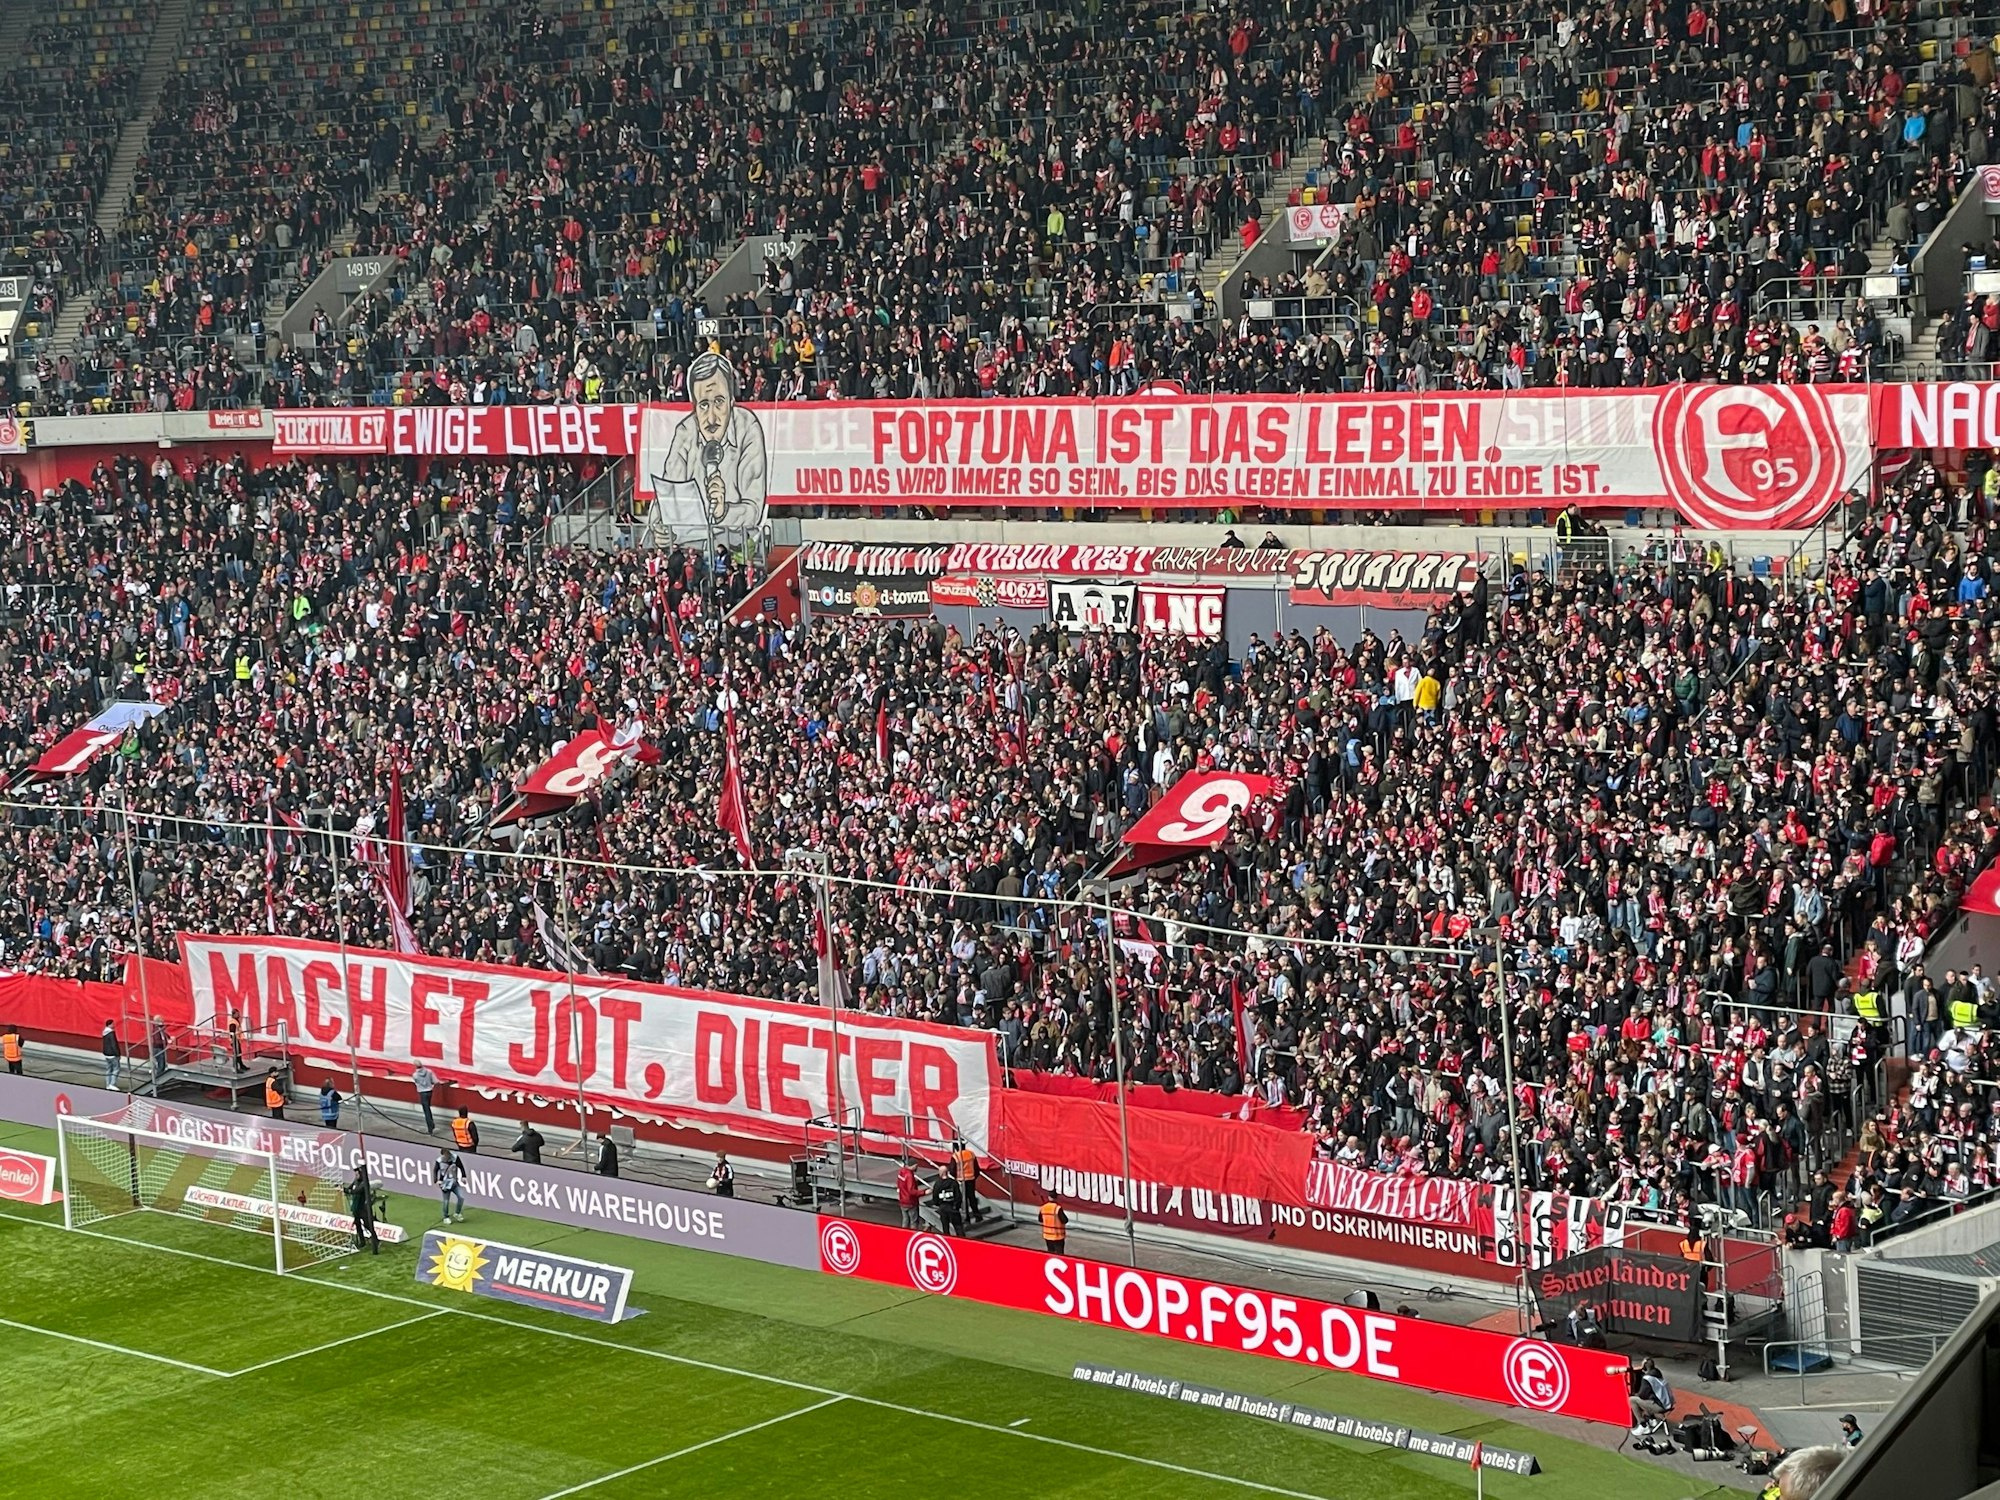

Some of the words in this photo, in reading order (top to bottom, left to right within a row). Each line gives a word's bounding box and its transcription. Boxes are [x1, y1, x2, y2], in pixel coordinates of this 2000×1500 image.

[347, 263, 363, 277] 149
[364, 262, 381, 276] 150
[0, 283, 15, 296] 48
[699, 321, 717, 335] 152
[273, 416, 353, 446] FORTUNA
[394, 408, 488, 454] EWIGE
[504, 406, 607, 456] LIEBE
[874, 408, 1079, 465] FORTUNA
[1097, 407, 1174, 464] IST
[1189, 405, 1291, 464] DAS
[1305, 402, 1502, 464] LEBEN.
[796, 468, 843, 494] UND
[850, 468, 890, 494] DAS
[897, 468, 947, 495] WIRD
[952, 468, 1021, 495] IMMER
[1029, 468, 1061, 494] SO
[1069, 467, 1128, 497] SEIN,
[1136, 468, 1177, 496] BIS
[1185, 468, 1229, 496] DAS
[1235, 468, 1311, 496] LEBEN
[1318, 466, 1420, 496] EINMAL
[1427, 466, 1457, 495] ZU
[1465, 464, 1543, 496] ENDE
[1553, 463, 1611, 495] IST.
[1752, 457, 1799, 491] 95
[854, 545, 914, 577] FIRE
[947, 543, 1070, 572] DIVISION
[1071, 545, 1155, 573] WEST
[1152, 546, 1217, 571] ANGRY
[1227, 548, 1293, 572] YOUTH
[997, 581, 1047, 600] 40625
[1294, 551, 1470, 600] SQUADRA
[1055, 592, 1078, 621] A
[1142, 593, 1223, 636] LNC
[1157, 778, 1251, 843] 9
[207, 951, 388, 1052] MACH
[411, 973, 491, 1066] ET
[508, 989, 667, 1099] JOT,
[694, 1010, 960, 1140] DIETER
[154, 1112, 274, 1154] LOGISTISCH
[279, 1135, 433, 1187] ERFOLGREICH
[459, 1166, 503, 1200] ANK
[510, 1176, 561, 1210] C&K
[565, 1185, 726, 1240] WAREHOUSE
[188, 1189, 220, 1205] KÜCHEN
[220, 1196, 252, 1211] AKTUELL
[1305, 1160, 1479, 1226] EINERZHAGEN
[256, 1202, 289, 1218] KÜCEN
[289, 1210, 323, 1225] AKTUELL
[1311, 1210, 1482, 1256] DISKRIMINIERUN
[840, 1252, 852, 1263] 95
[493, 1255, 612, 1304] MERKUR
[931, 1270, 945, 1283] 95
[1044, 1257, 1400, 1378] SHOP.F95.DE
[1073, 1366, 1091, 1380] me
[1092, 1370, 1116, 1385] and
[1115, 1373, 1131, 1388] all
[1131, 1376, 1168, 1396] hotels
[1536, 1382, 1554, 1398] 95
[1180, 1386, 1200, 1402] me
[1200, 1391, 1225, 1407] and
[1224, 1396, 1239, 1411] all
[1241, 1399, 1279, 1420] hotels
[1292, 1406, 1312, 1426] me
[1312, 1414, 1338, 1433] and
[1336, 1419, 1354, 1436] all
[1354, 1421, 1395, 1444] hotels
[1409, 1436, 1429, 1452] me
[1430, 1441, 1456, 1457] and
[1457, 1444, 1473, 1463] all
